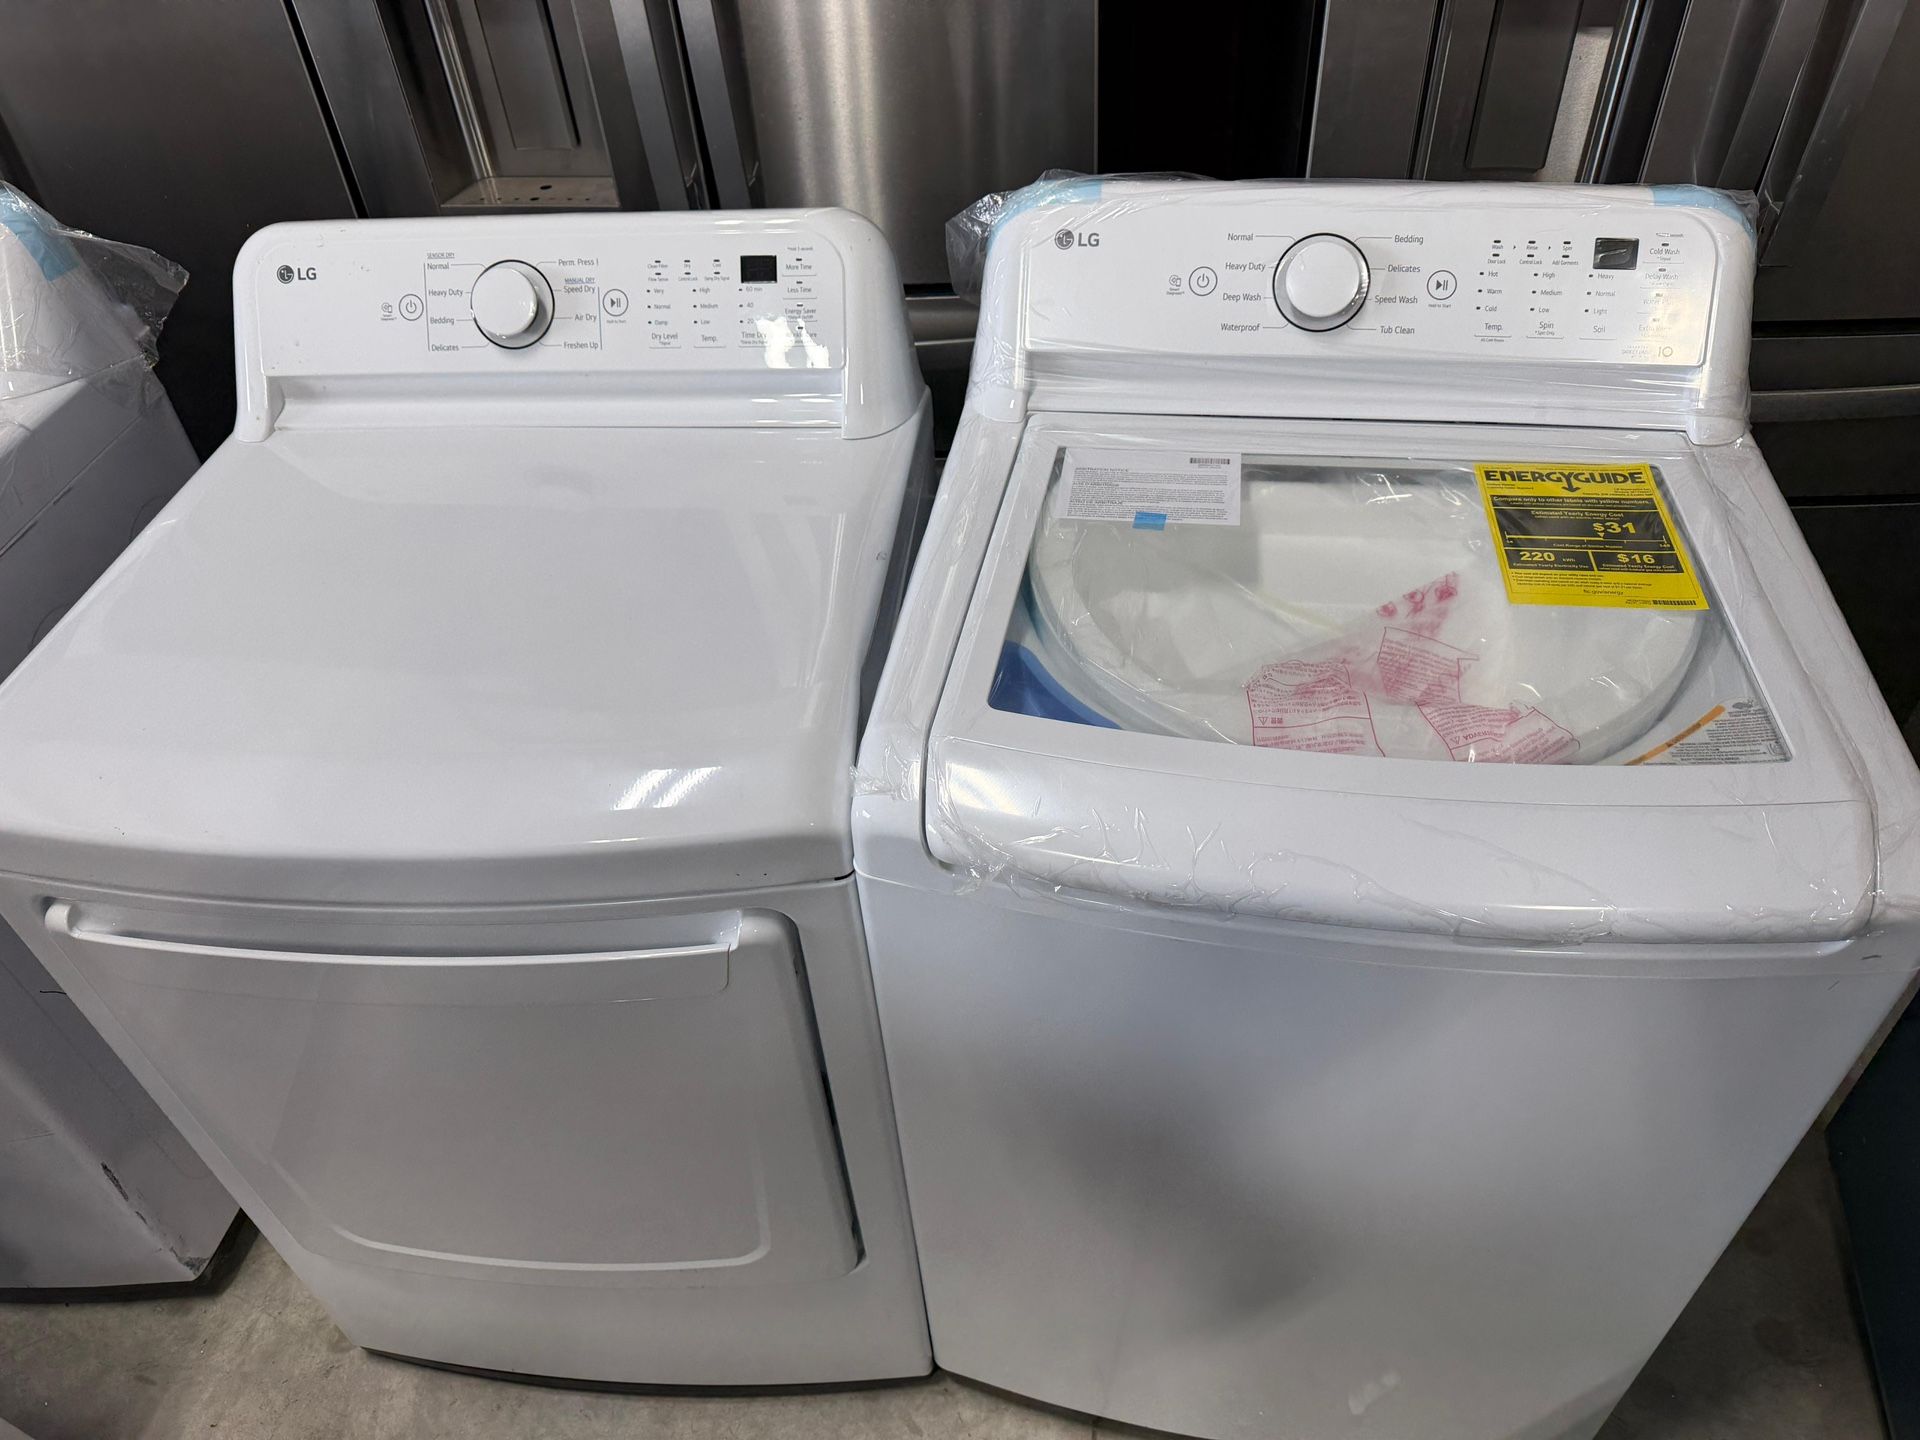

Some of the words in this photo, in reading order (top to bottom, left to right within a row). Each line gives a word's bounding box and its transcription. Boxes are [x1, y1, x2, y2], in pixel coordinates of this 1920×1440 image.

[1078, 232, 1100, 247] LG
[1227, 233, 1254, 241] Normal
[1394, 235, 1424, 245] Bedding
[577, 258, 594, 266] Press
[1225, 262, 1247, 271] Heavy
[1249, 262, 1266, 272] Duty
[1387, 265, 1421, 273] Delicates
[298, 267, 317, 281] LG
[1542, 272, 1555, 280] High
[1598, 273, 1614, 281] Heavy
[1645, 273, 1661, 281] Delay
[428, 289, 447, 297] Heavy
[448, 289, 463, 297] Duty
[584, 285, 595, 294] Dry
[1222, 292, 1241, 302] Deep
[1242, 293, 1261, 301] Wash
[1375, 295, 1396, 304] Speed
[1398, 296, 1418, 304] Wash
[785, 308, 800, 316] Energy
[1593, 308, 1608, 316] Light
[430, 317, 454, 325] Bedding
[586, 314, 597, 322] Dry
[1220, 323, 1260, 332] Waterproof
[1380, 326, 1392, 334] Tub
[1394, 326, 1415, 334] Clean
[1484, 322, 1503, 331] Temp.
[1539, 321, 1554, 330] Spin
[1593, 325, 1606, 333] Soil
[652, 333, 661, 341] Dry
[663, 332, 679, 340] Level
[701, 334, 718, 343] Temp.
[563, 341, 588, 349] Freshen
[589, 341, 598, 349] Up
[1484, 469, 1645, 489] ENERGYGUIDE
[1593, 522, 1636, 534] $31
[1520, 551, 1555, 562] 220
[1616, 553, 1656, 564] $16
